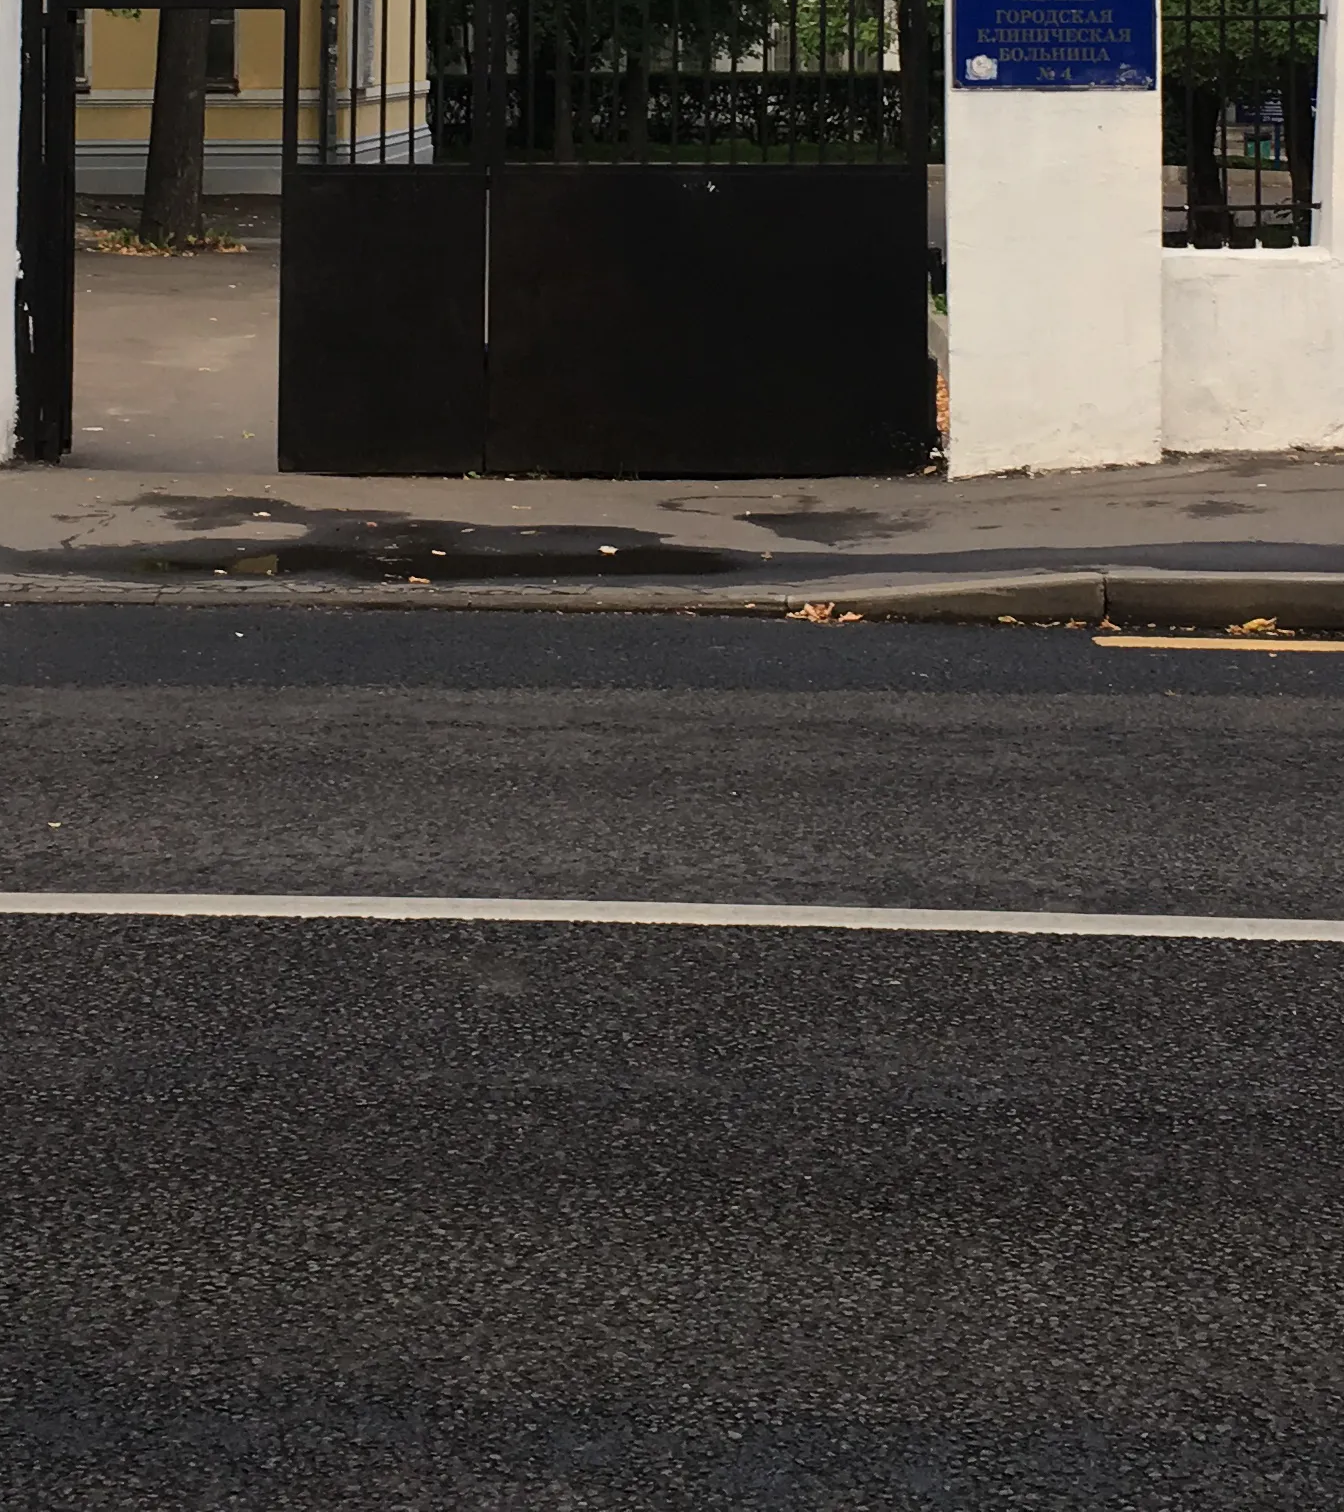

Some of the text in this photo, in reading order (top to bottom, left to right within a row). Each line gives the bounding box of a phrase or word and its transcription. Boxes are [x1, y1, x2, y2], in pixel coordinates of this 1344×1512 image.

[995, 9, 1114, 26] ГОРОДСКАЯ
[977, 28, 1132, 43] КЛИНИЧЕСКАЯ
[998, 47, 1111, 63] БОЛЬНИЦА
